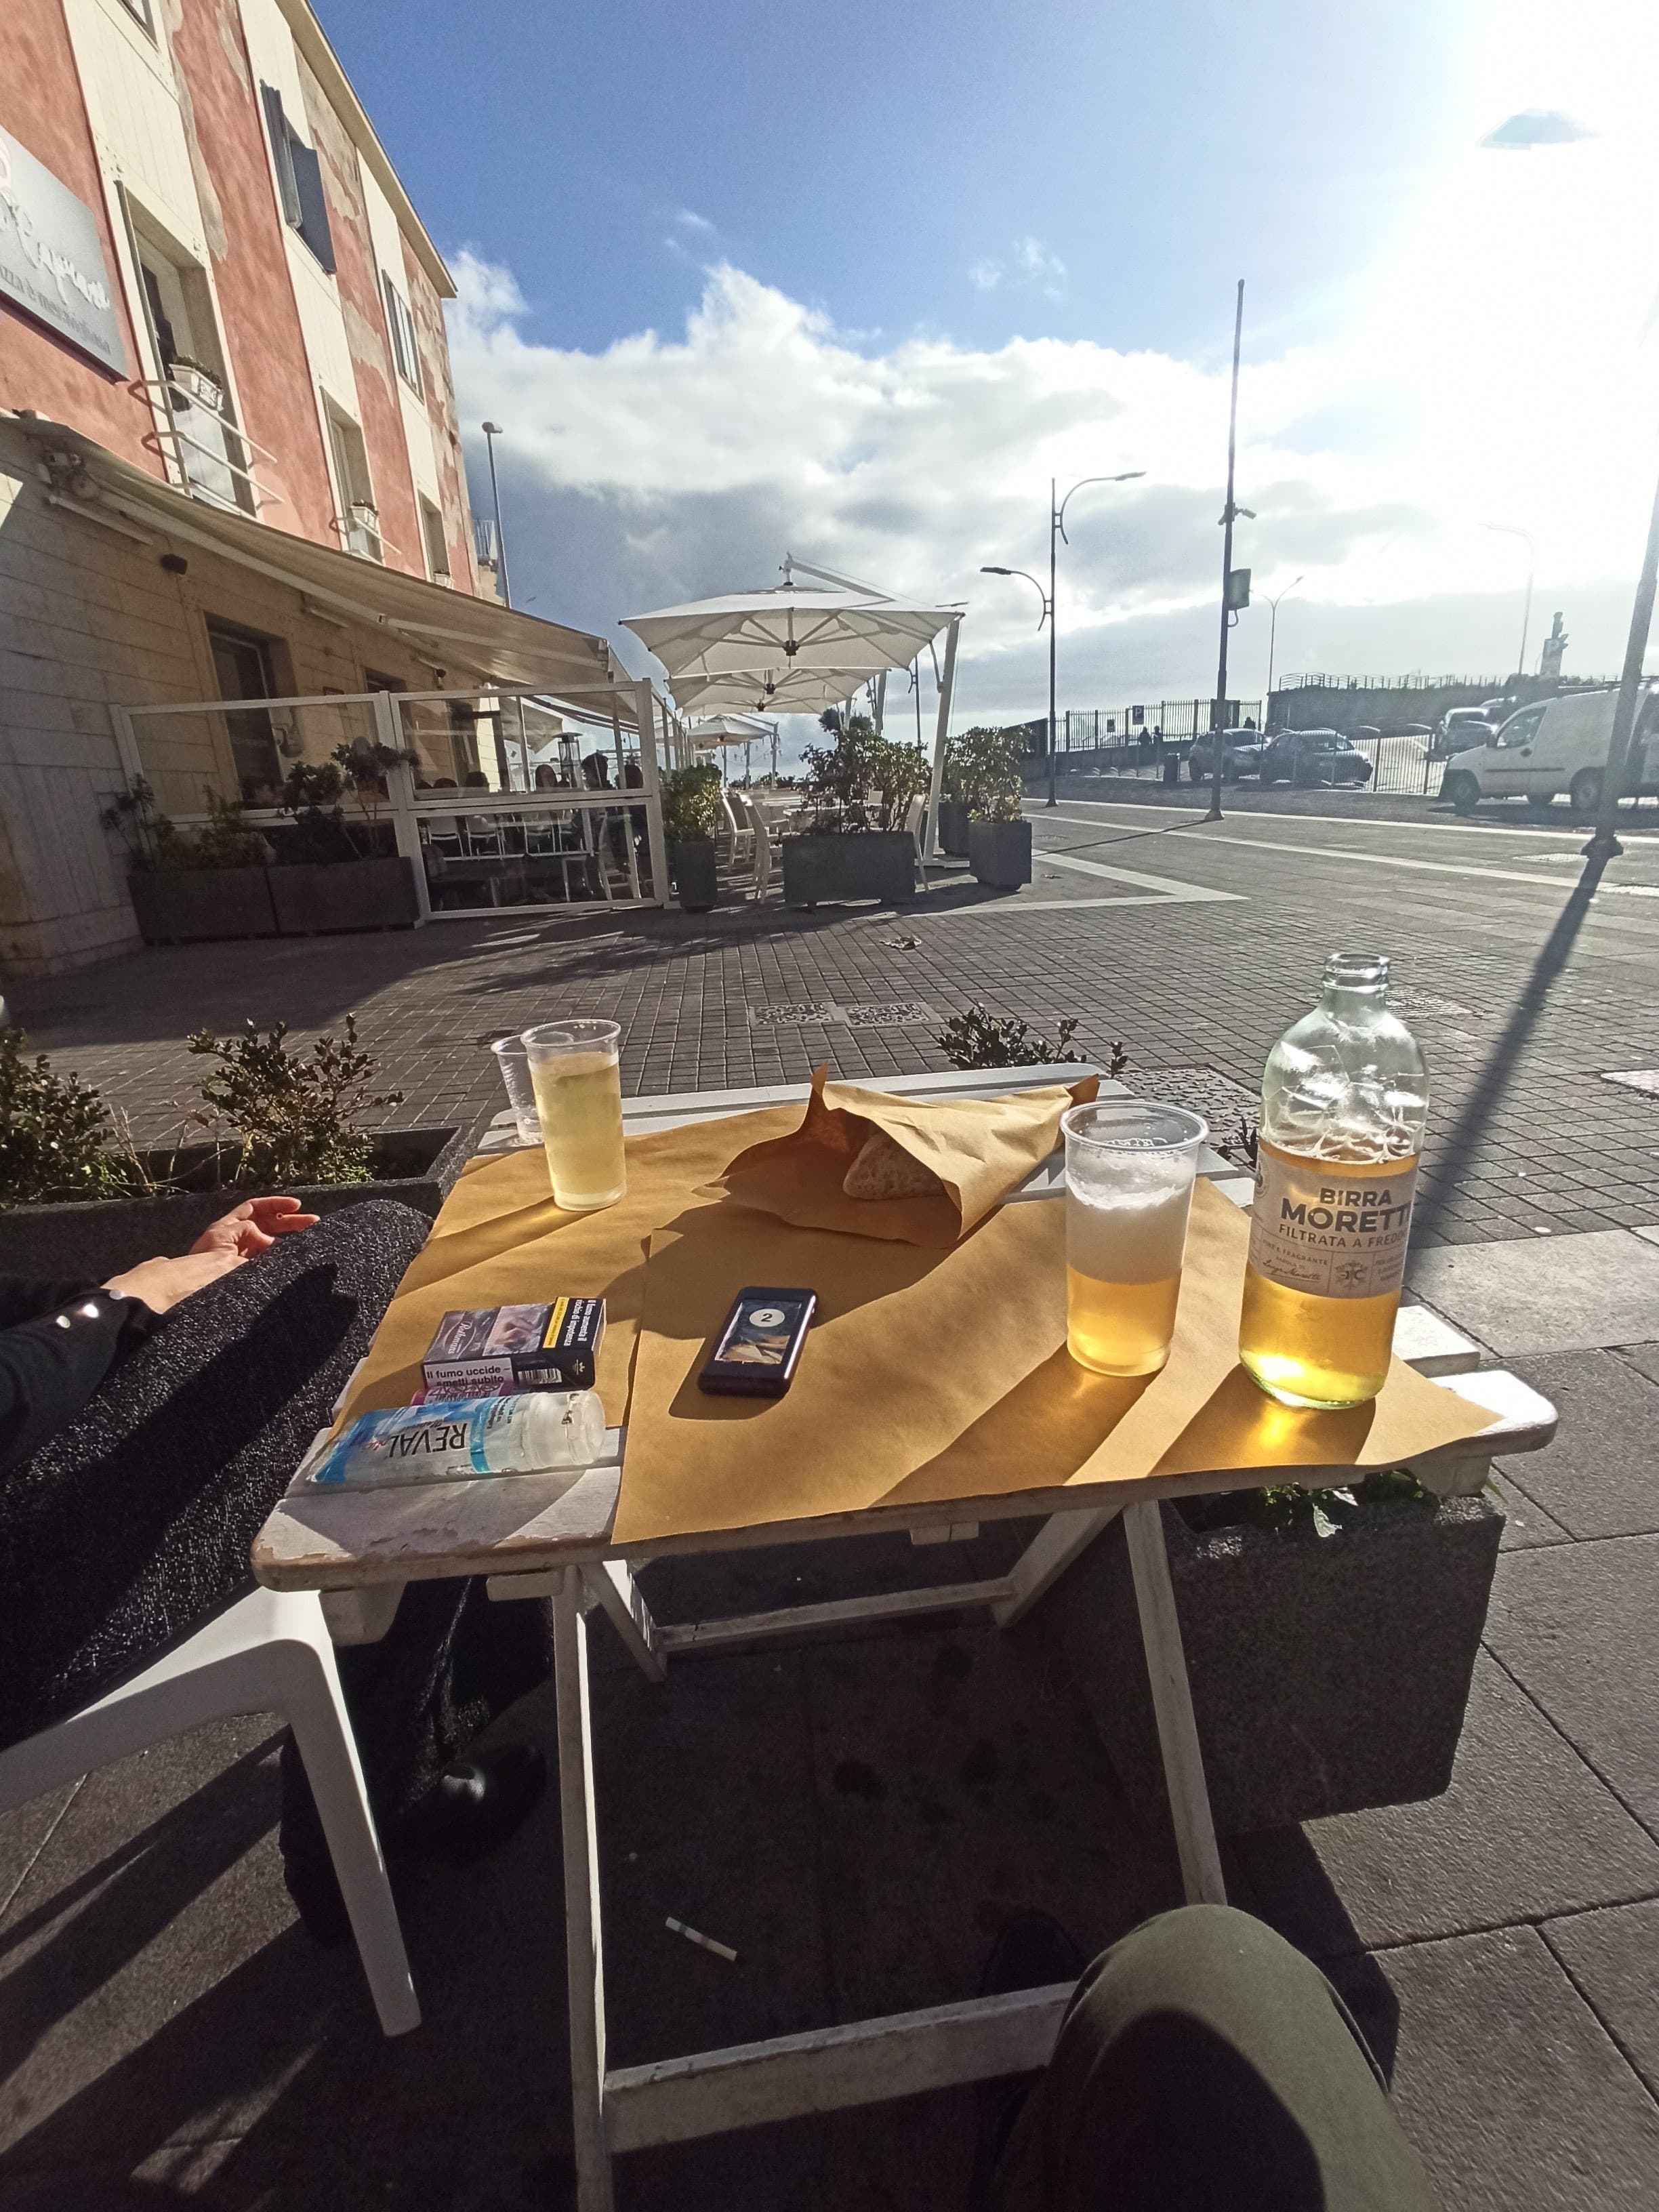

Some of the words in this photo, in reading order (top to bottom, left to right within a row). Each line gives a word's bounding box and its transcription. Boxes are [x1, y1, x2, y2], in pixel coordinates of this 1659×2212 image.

[1135, 708, 1142, 717] P
[1319, 1187, 1392, 1207] BIRRA
[1279, 1224, 1347, 1248] FILTRATA
[1352, 1240, 1361, 1248] A
[1368, 1230, 1406, 1248] FREDD
[1283, 1249, 1328, 1265] FRAGRANTE
[573, 1299, 584, 1314] rischio
[585, 1303, 596, 1315] fumo
[760, 1313, 773, 1322] 2
[563, 1320, 579, 1347] impotenza
[578, 1316, 590, 1337] aumenta
[448, 1320, 472, 1354] Rothmans
[426, 1371, 433, 1379] Il
[436, 1370, 463, 1378] fumo
[466, 1366, 501, 1376] uccide
[436, 1377, 468, 1387] smetti
[471, 1375, 504, 1385] subito
[390, 1422, 468, 1458] REVAL
